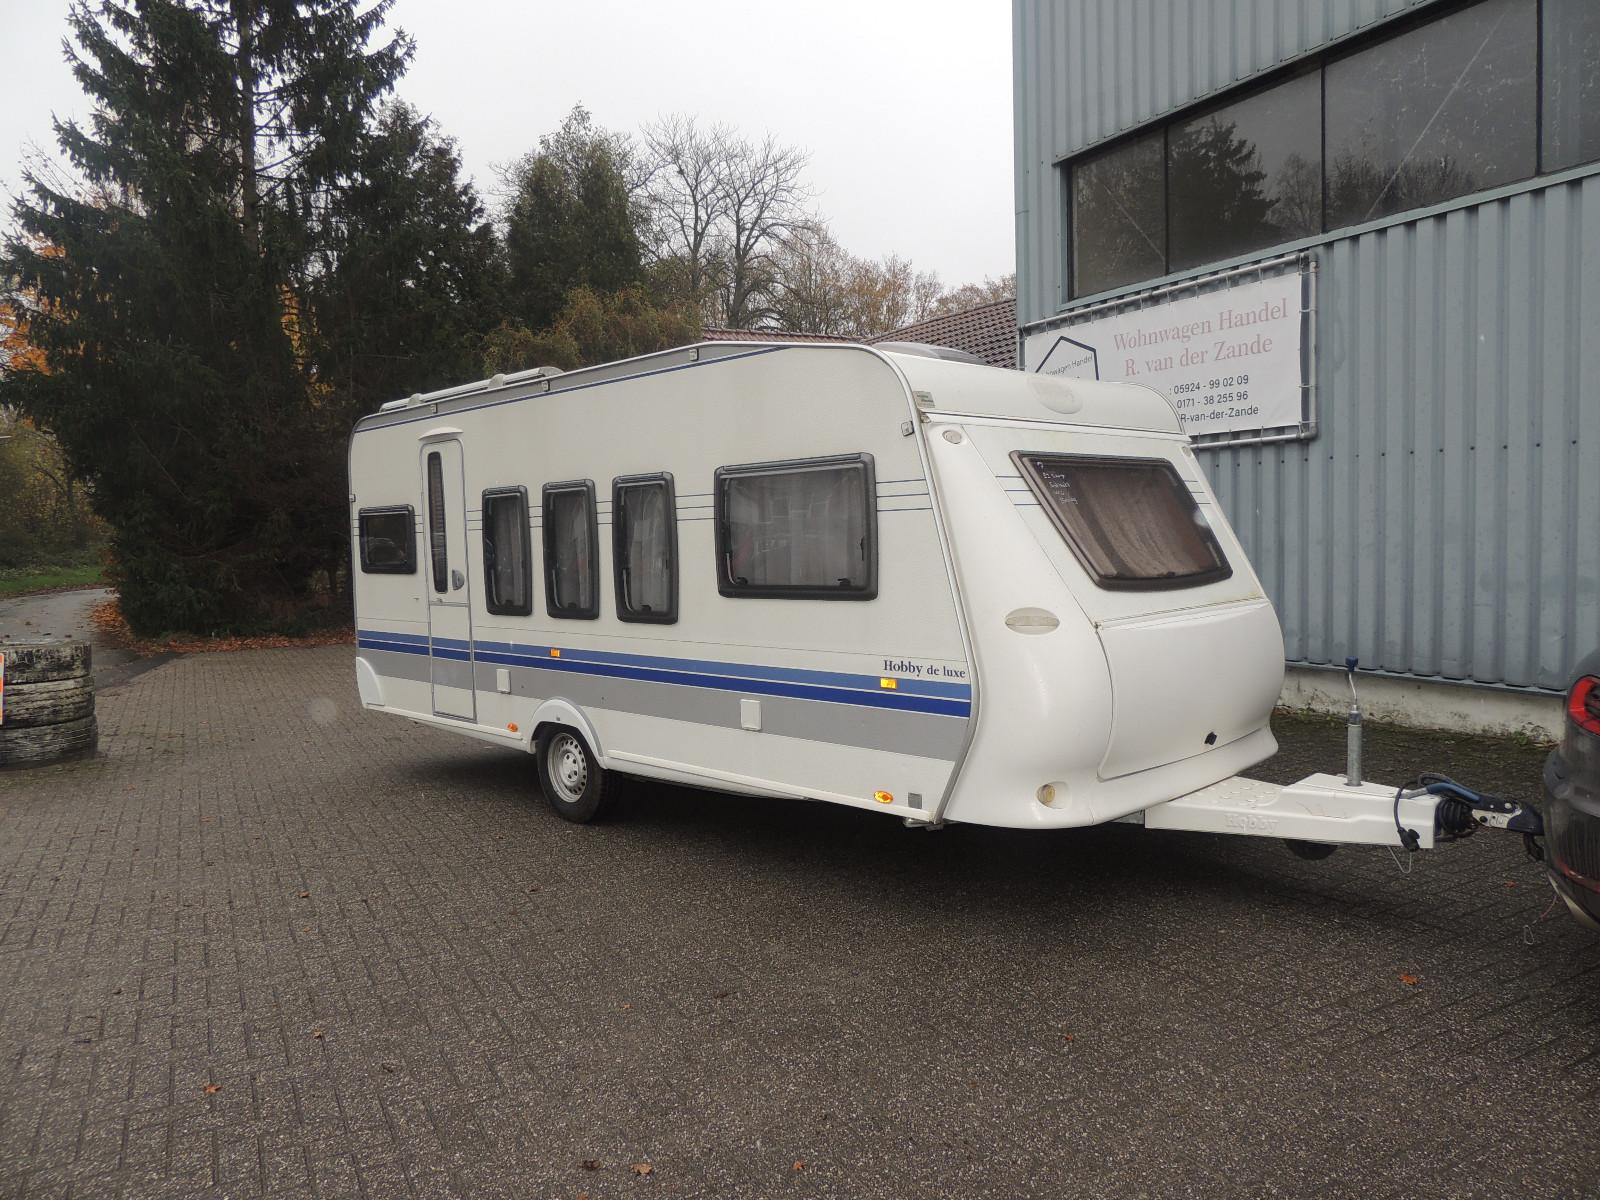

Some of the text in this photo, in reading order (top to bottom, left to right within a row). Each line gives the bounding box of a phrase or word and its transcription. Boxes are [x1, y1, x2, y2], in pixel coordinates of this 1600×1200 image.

[1113, 298, 1288, 351] Wohnwagen Handel
[1072, 353, 1093, 367] Handel
[1125, 334, 1273, 376] R. van der Zande
[1174, 382, 1201, 395] 05924
[1209, 379, 1220, 389] 99
[1223, 376, 1234, 387] 02
[1236, 374, 1249, 385] 09
[1177, 398, 1195, 409] 0171
[1203, 395, 1215, 406] 38
[1217, 392, 1234, 404] 255
[1236, 390, 1249, 401] 96
[1180, 404, 1259, 423] R-van-der-Zande
[883, 659, 966, 678] Hobby de luxe
